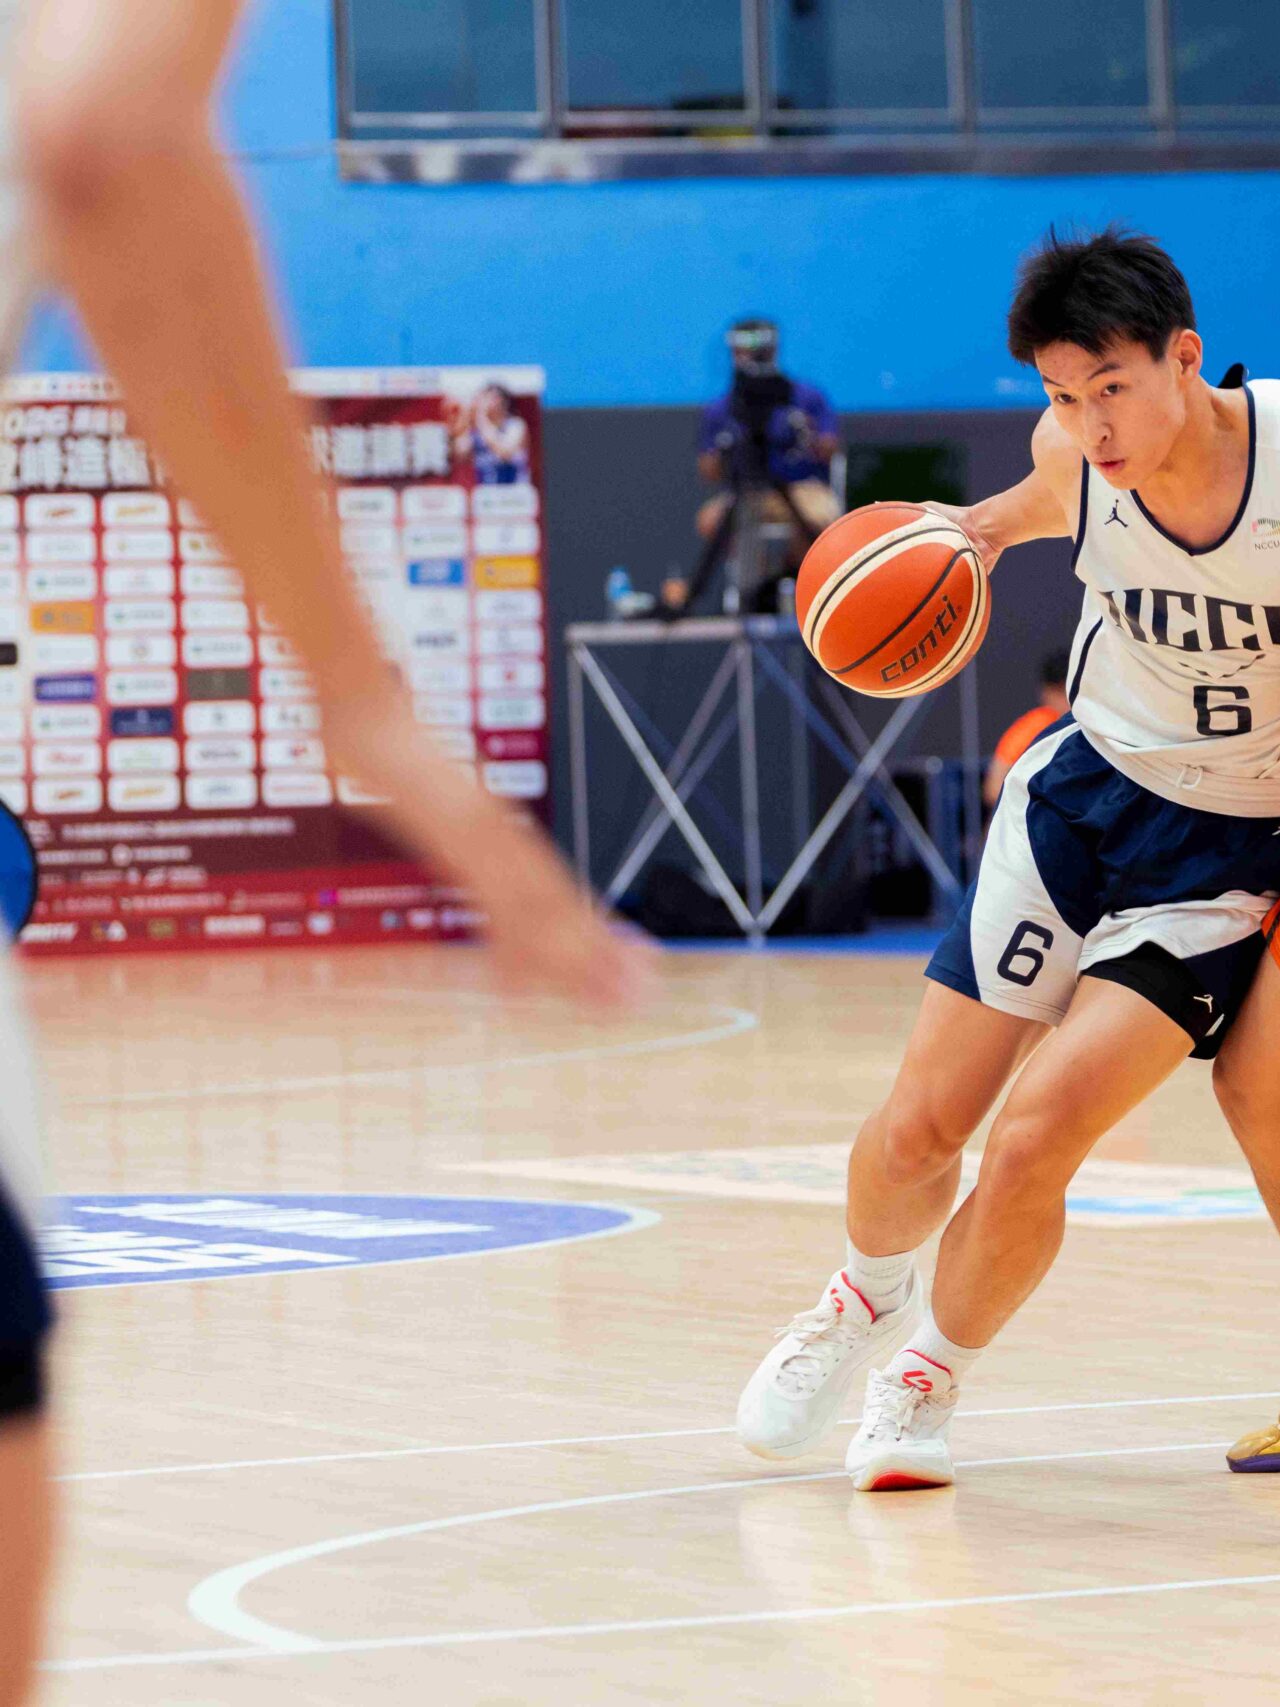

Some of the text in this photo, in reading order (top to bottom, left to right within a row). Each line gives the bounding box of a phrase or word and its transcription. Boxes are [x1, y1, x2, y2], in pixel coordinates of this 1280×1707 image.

[1254, 539, 1280, 551] NCCU
[880, 595, 958, 683] conti
[1193, 685, 1252, 736] 6
[997, 920, 1054, 987] 6
